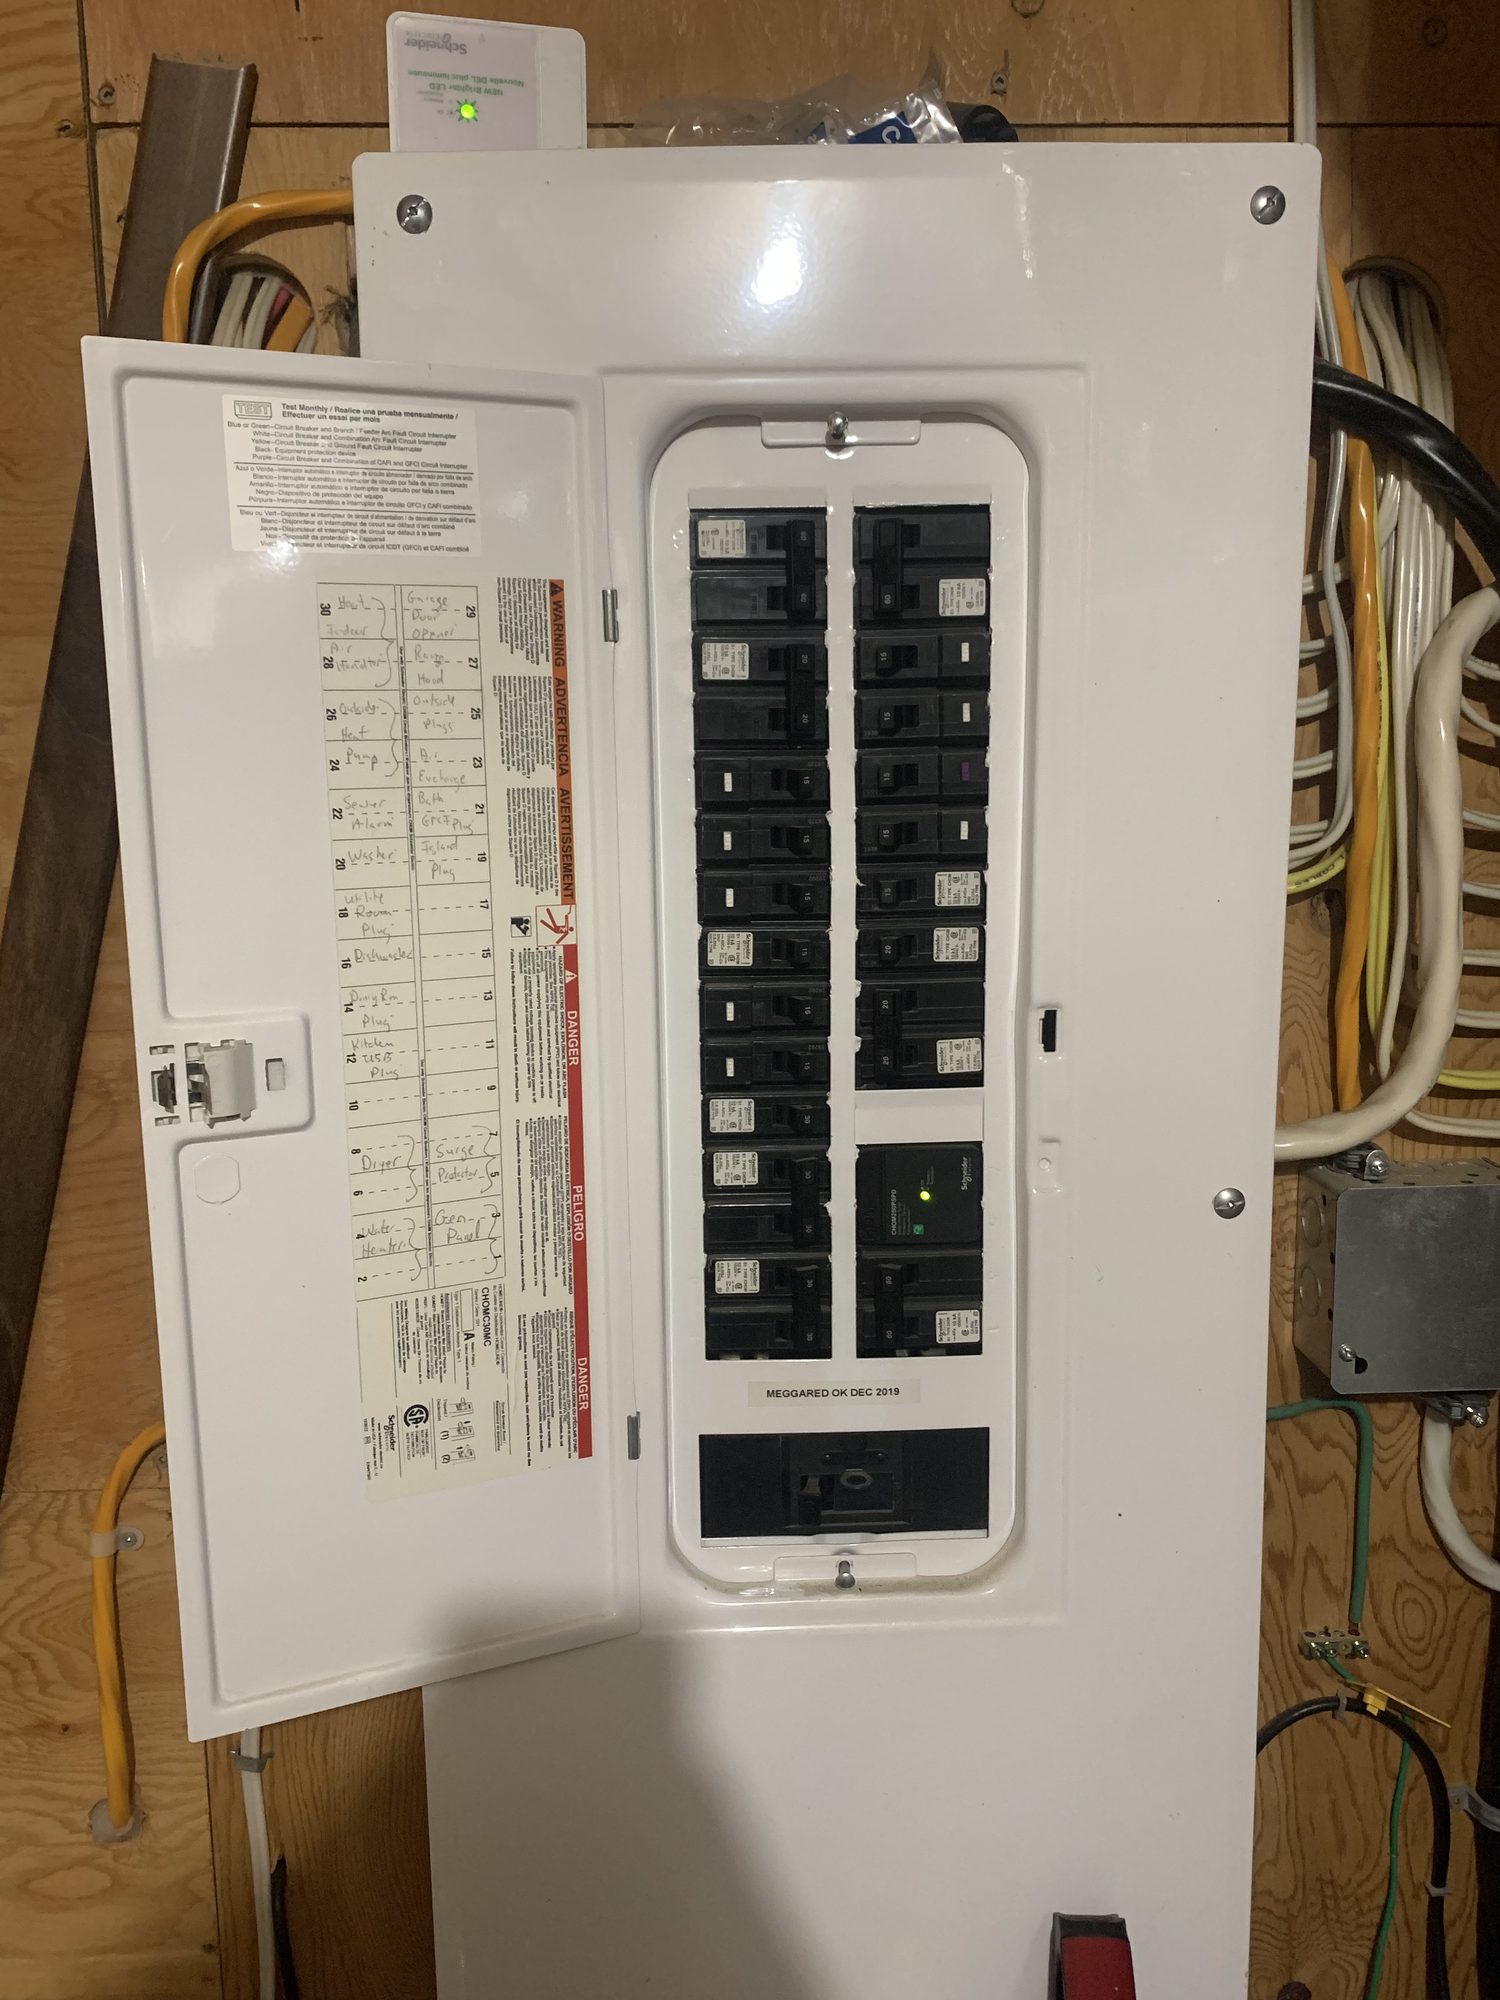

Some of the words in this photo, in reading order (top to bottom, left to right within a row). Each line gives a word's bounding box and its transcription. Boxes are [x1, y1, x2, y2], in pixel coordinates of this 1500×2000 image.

[404, 34, 467, 54] Schneider
[452, 73, 468, 81] plus
[471, 75, 489, 83] DEL
[490, 78, 524, 87] Nouvelle
[429, 82, 446, 90] LED
[484, 88, 503, 96] NEW
[235, 401, 271, 415] TEST
[299, 403, 328, 413] Monthly
[335, 405, 360, 415] Realice
[377, 409, 402, 417] prueba
[404, 411, 454, 420] mensualmente
[282, 410, 316, 419] Effectuer
[328, 413, 348, 421] essai
[363, 415, 381, 423] mois
[884, 594, 892, 605] 60
[320, 602, 331, 617] 30
[466, 605, 476, 619] 29
[552, 600, 566, 668] WARNING
[323, 656, 334, 670] 28
[468, 656, 478, 670] 27
[801, 654, 809, 665] 20
[880, 651, 888, 662] 15
[326, 707, 337, 722] 26
[470, 706, 481, 721] 25
[802, 713, 809, 724] 20
[884, 711, 891, 721] 15
[555, 678, 569, 777] ADVERTENCIA
[329, 758, 340, 772] 24
[345, 747, 379, 772] Pump
[472, 756, 483, 769] 23
[803, 775, 810, 785] 15
[883, 771, 891, 781] 15
[343, 794, 386, 810] Sewer
[418, 790, 444, 806] Bath
[332, 807, 343, 821] 22
[474, 803, 485, 815] 21
[351, 817, 393, 831] Alarm
[803, 834, 810, 844] 15
[883, 828, 890, 839] 15
[559, 787, 574, 900] AVERTISSEMENT
[347, 846, 395, 863] Washer
[477, 851, 487, 863] 19
[335, 857, 346, 871] 20
[804, 892, 811, 902] 15
[884, 887, 892, 897] 15
[936, 879, 945, 905] Schneider
[479, 898, 489, 910] 17
[338, 906, 349, 919] 18
[481, 947, 491, 959] 15
[743, 934, 752, 960] Schneider
[801, 947, 808, 957] 15
[884, 944, 892, 955] 20
[935, 934, 944, 960] Schneider
[341, 957, 352, 970] 16
[483, 989, 493, 1001] 13
[343, 1001, 354, 1014] 14
[882, 999, 889, 1010] 20
[351, 1037, 395, 1051] Kitchen
[485, 1038, 495, 1050] 11
[567, 1010, 580, 1066] DANGER
[346, 1052, 357, 1064] 12
[882, 1055, 890, 1066] 20
[938, 1046, 948, 1072] Schneider
[348, 1099, 359, 1112] 10
[744, 1100, 753, 1126] Schneider
[435, 1143, 475, 1161] Surge
[361, 1154, 402, 1175] Dryer
[438, 1167, 479, 1183] Protector
[961, 1156, 973, 1191] Schneider
[491, 1211, 501, 1219] 3
[572, 1185, 585, 1242] PELIGRO
[357, 1275, 368, 1283] 2
[750, 1262, 758, 1287] Schneider
[806, 1279, 814, 1289] 30
[481, 1286, 492, 1347] CHOMC30MC
[464, 1331, 476, 1342] A
[938, 1318, 946, 1342] Schneider
[577, 1357, 589, 1411] DANGER
[766, 1389, 830, 1398] MEGGARED
[831, 1388, 848, 1397] OK
[850, 1388, 873, 1397] DEC
[875, 1387, 900, 1396] 2019
[385, 1414, 396, 1452] Schneider
[440, 1430, 450, 1441] (1)
[441, 1453, 451, 1465] (2)
